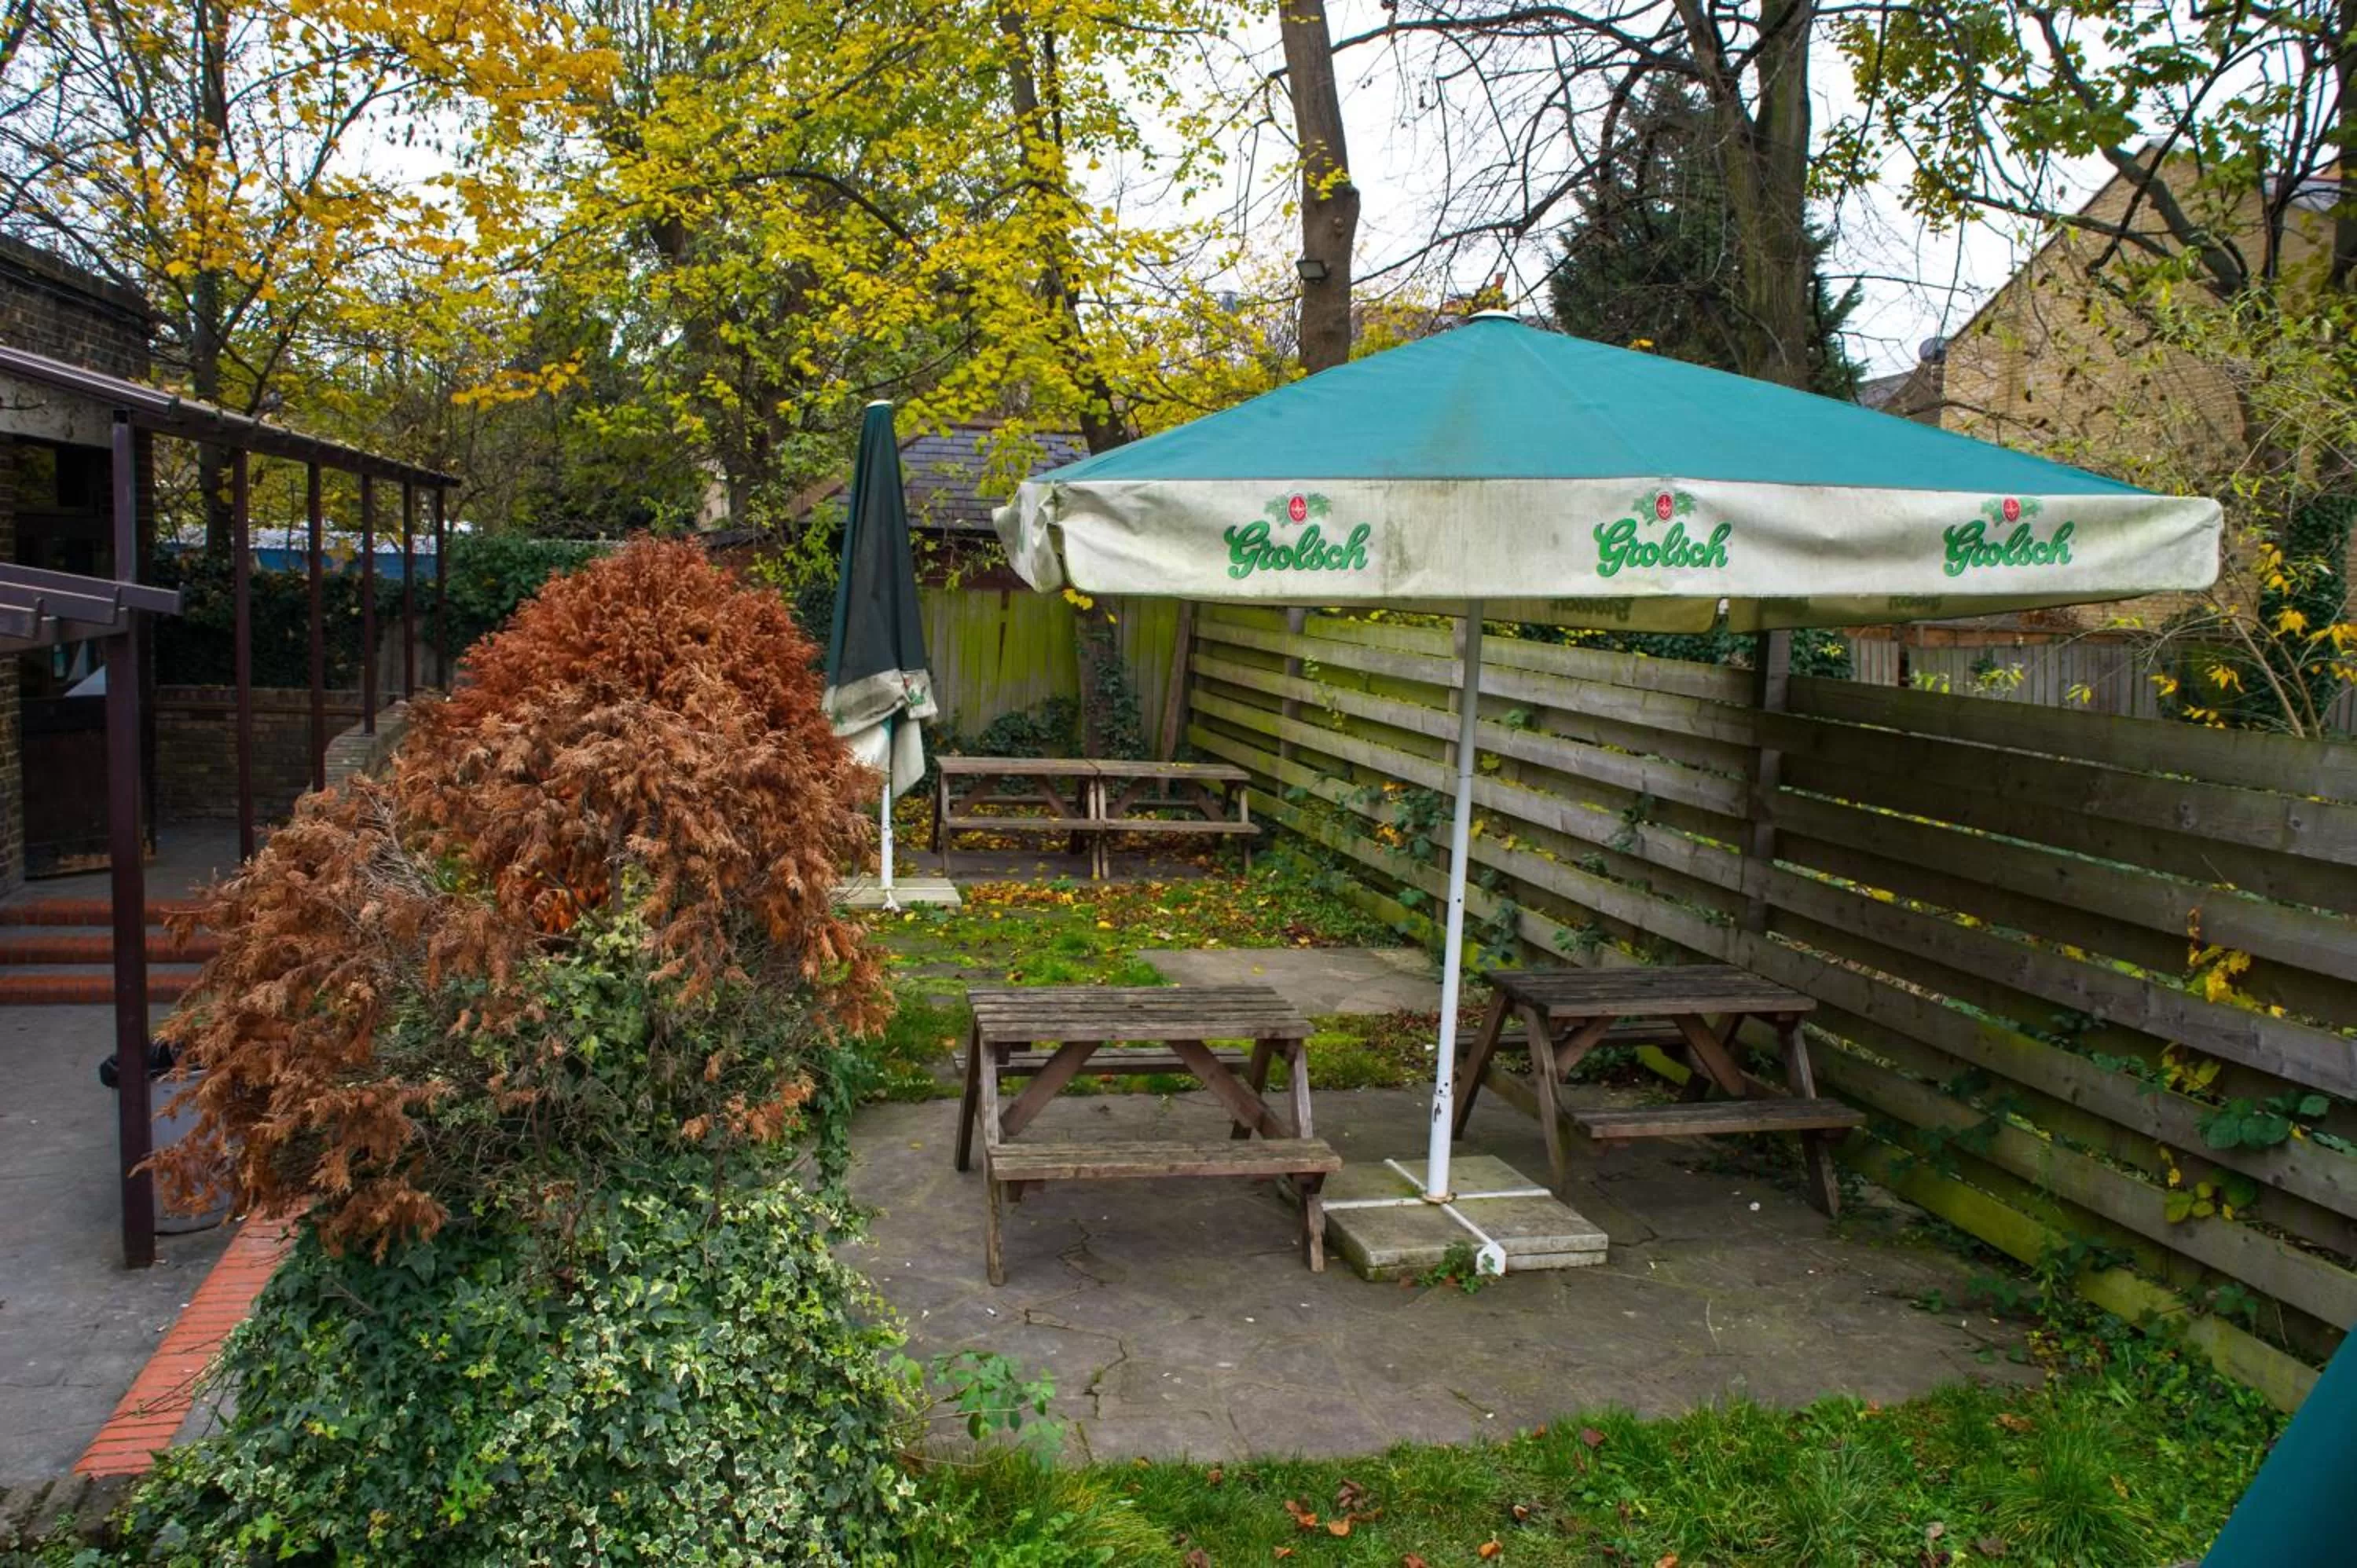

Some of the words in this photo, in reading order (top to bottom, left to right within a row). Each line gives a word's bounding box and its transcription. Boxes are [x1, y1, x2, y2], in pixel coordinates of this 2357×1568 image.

[1223, 521, 1371, 579] Grolsch
[1593, 518, 1732, 577] Grolsch
[1942, 519, 2075, 577] Grolsch
